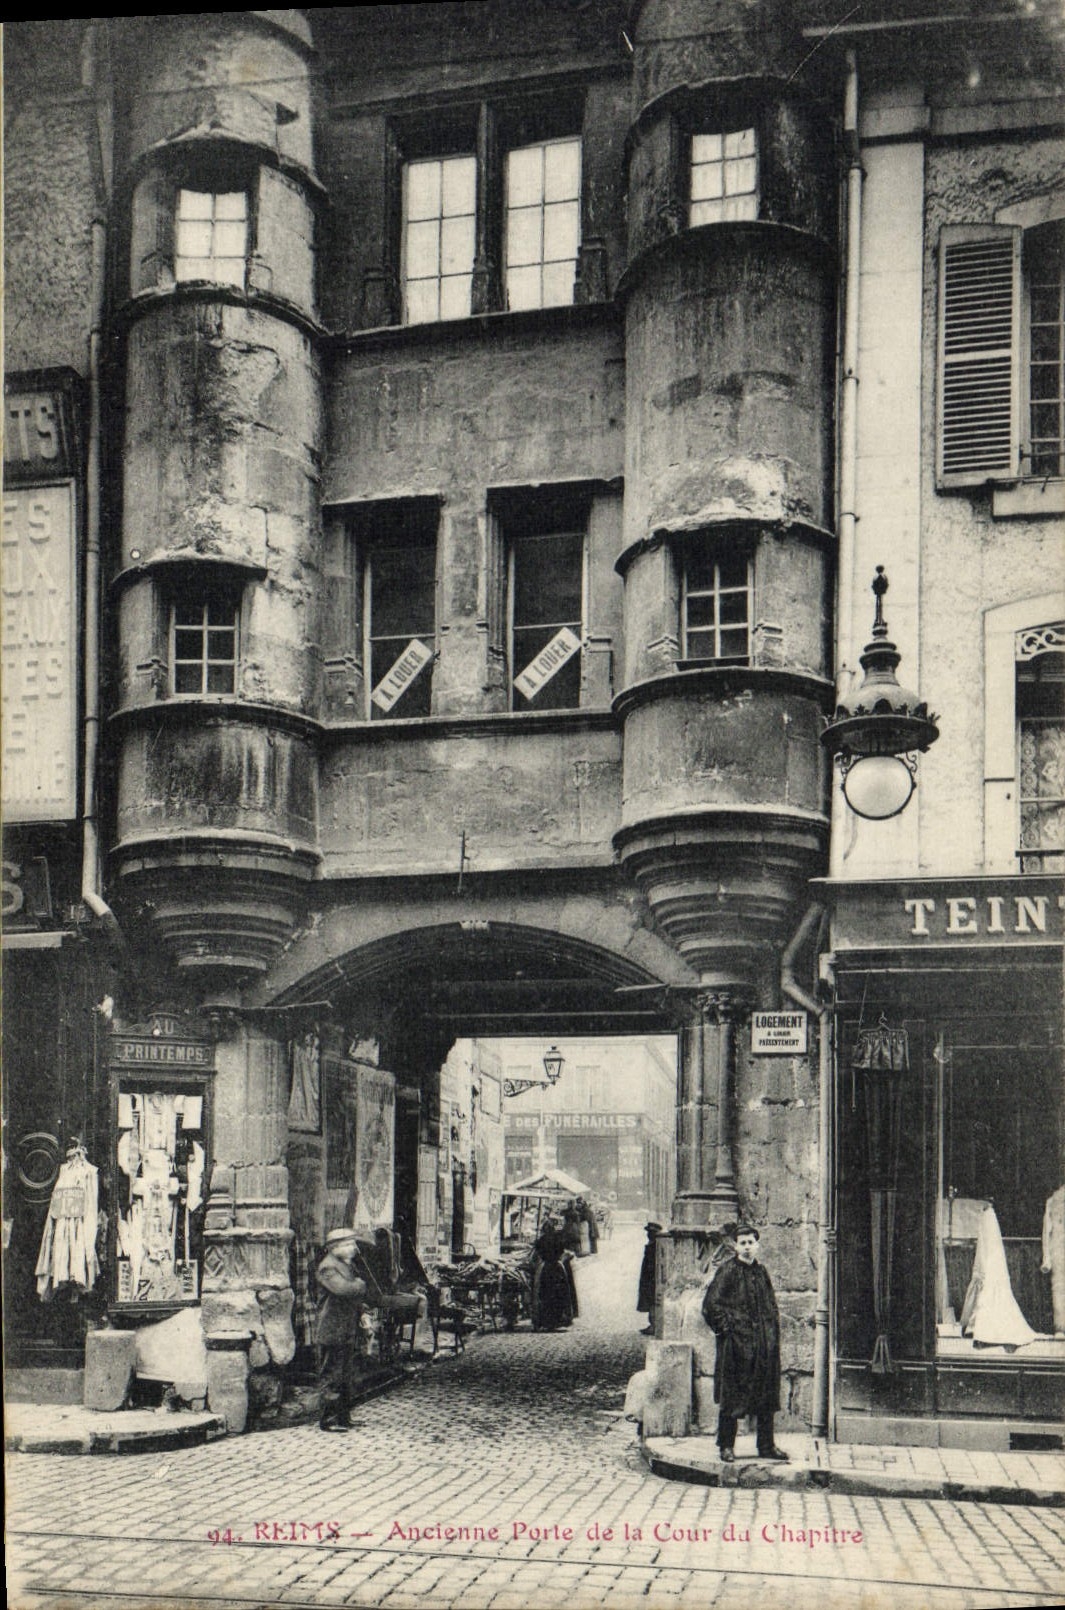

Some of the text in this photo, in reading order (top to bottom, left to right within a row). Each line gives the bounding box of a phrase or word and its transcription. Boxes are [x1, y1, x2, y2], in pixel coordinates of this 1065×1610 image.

[380, 650, 424, 701] A LOUER
[523, 639, 572, 688] A LOUER
[904, 896, 1065, 936] TEIN
[151, 1019, 175, 1034] AU
[755, 1015, 803, 1028] LOGEMENT
[121, 1043, 205, 1061] PRINTEMPS
